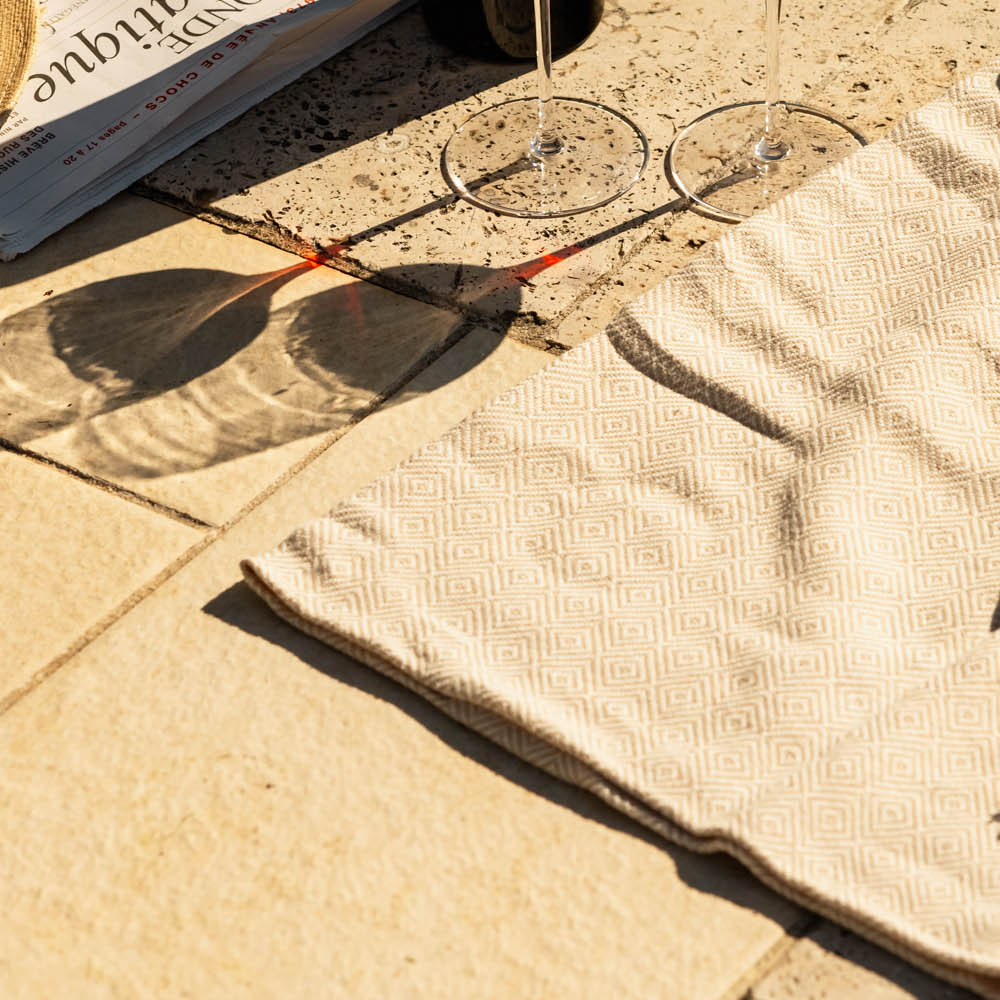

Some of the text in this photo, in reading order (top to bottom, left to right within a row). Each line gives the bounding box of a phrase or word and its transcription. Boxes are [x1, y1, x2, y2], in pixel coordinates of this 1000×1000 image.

[200, 51, 224, 69] DE
[144, 72, 196, 110] CHOCS
[12, 117, 27, 126] PAR
[20, 125, 43, 142] DES
[98, 121, 127, 141] pages
[85, 140, 98, 151] 17
[62, 154, 77, 165] 20
